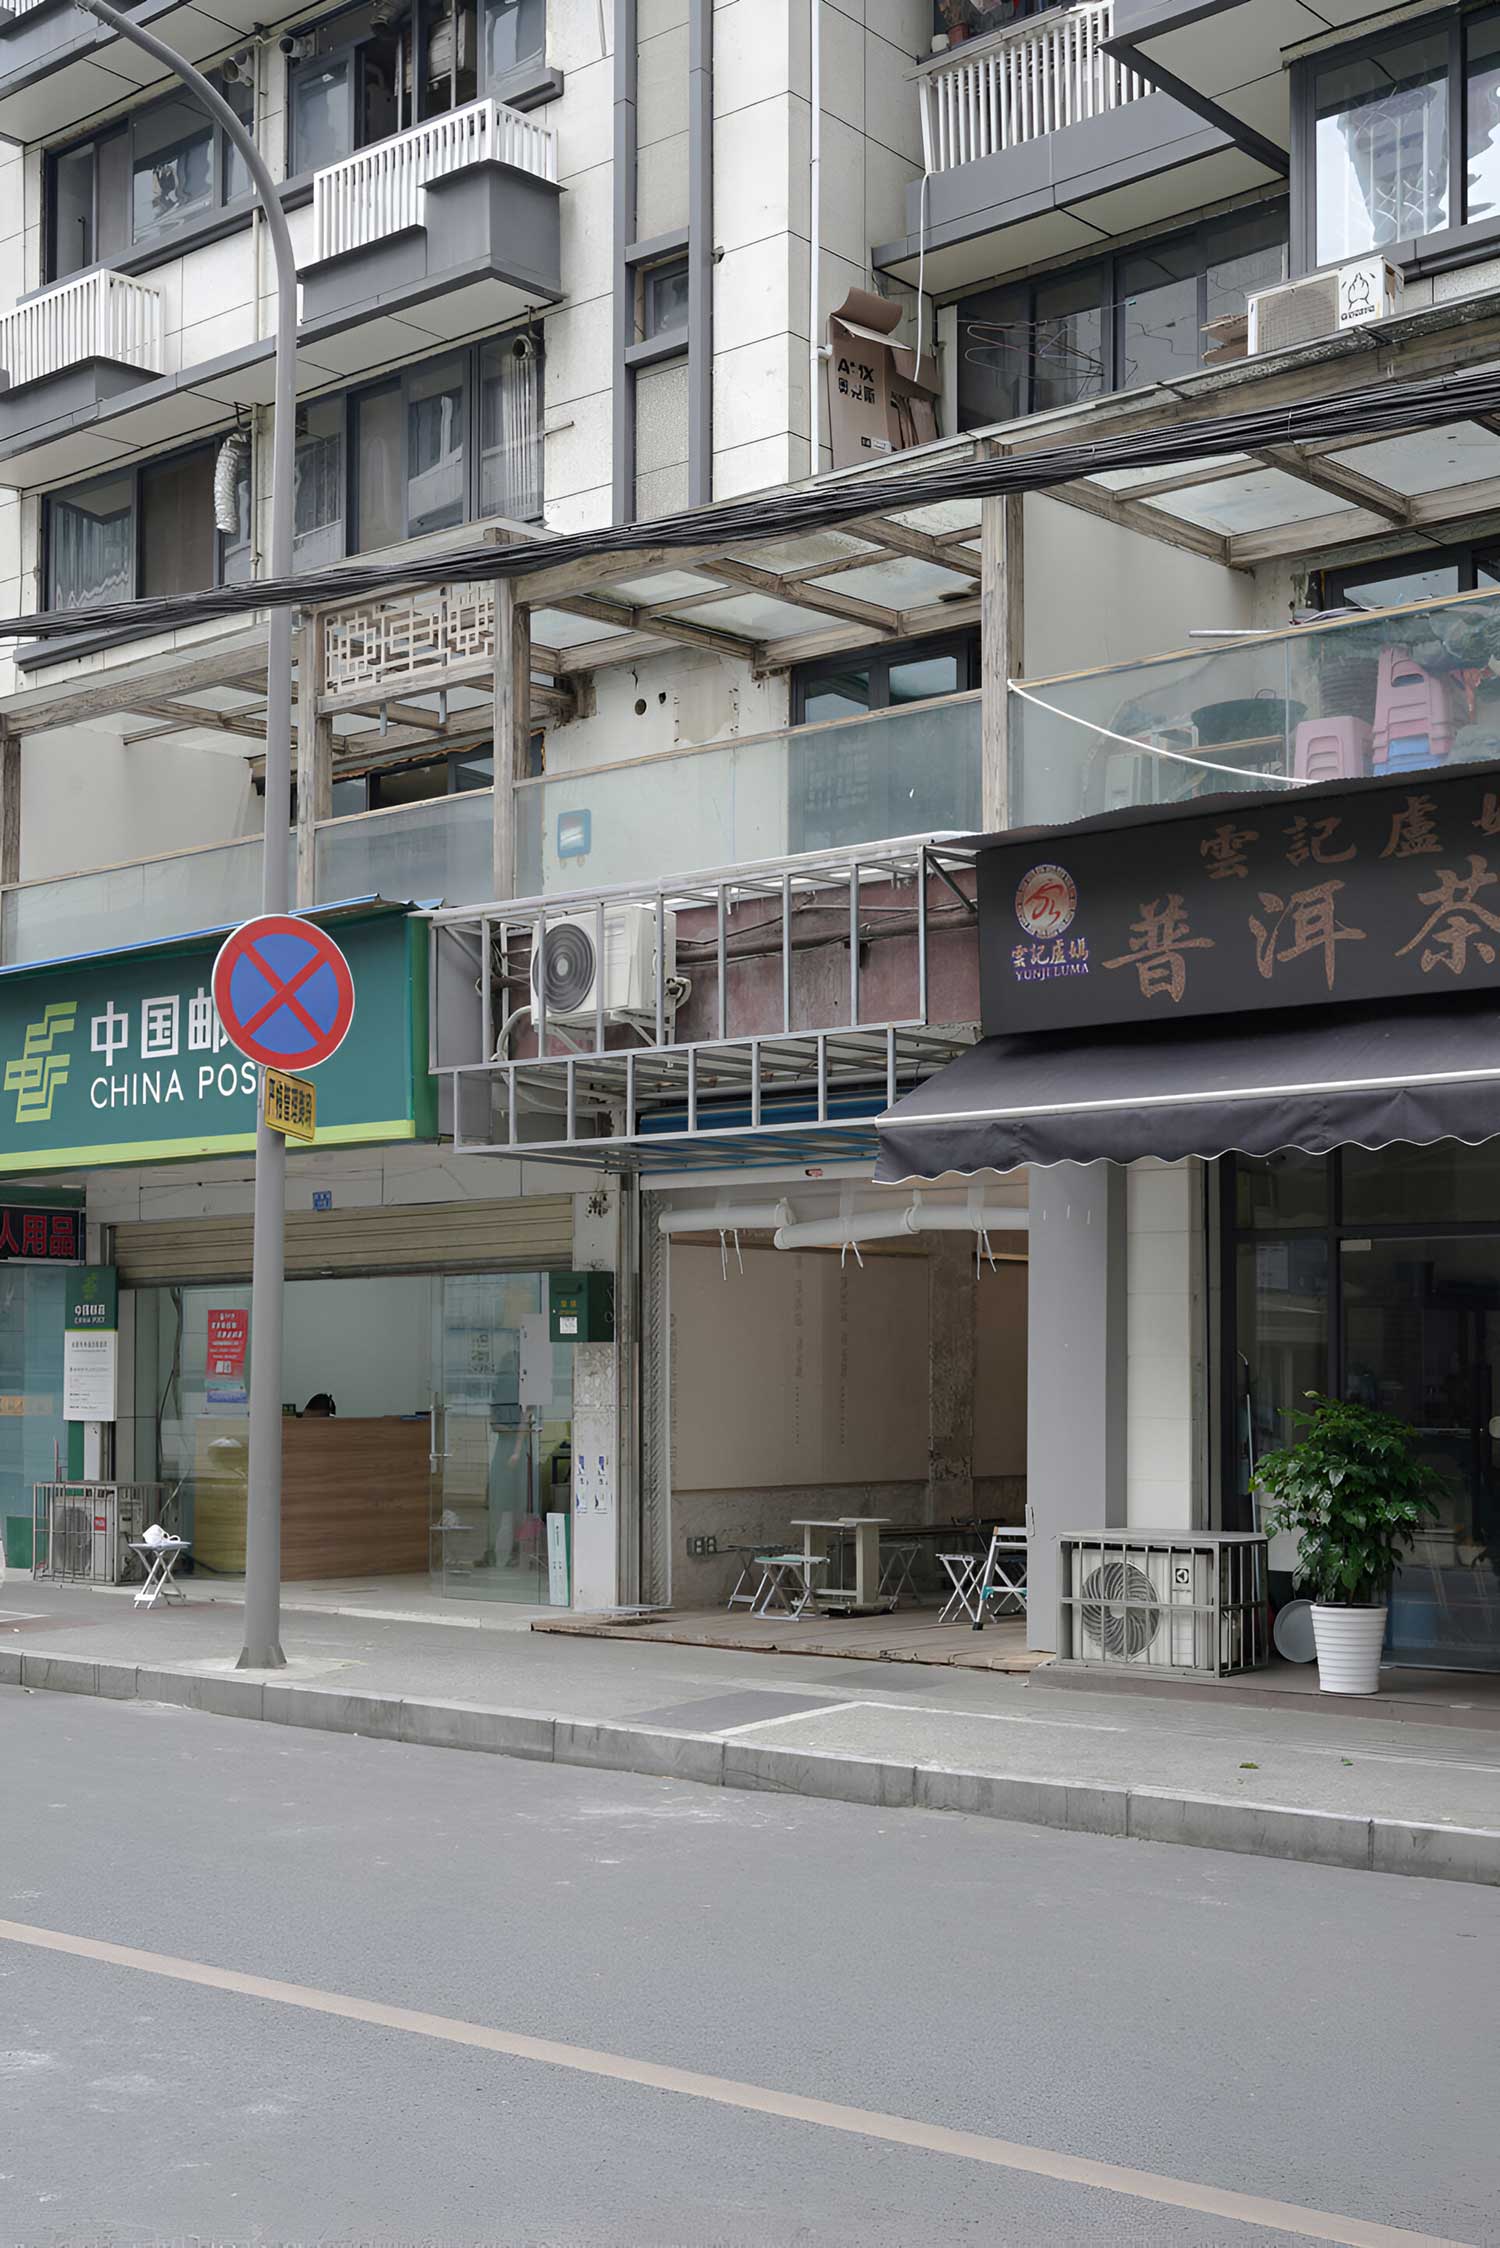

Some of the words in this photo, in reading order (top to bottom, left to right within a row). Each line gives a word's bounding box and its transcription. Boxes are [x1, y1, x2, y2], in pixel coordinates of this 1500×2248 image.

[1102, 855, 1500, 1004] 普洱茶
[90, 987, 229, 1067] 中国邮
[90, 1069, 184, 1109] CHINA
[198, 1061, 257, 1099] POS
[0, 1209, 75, 1257] 人用品
